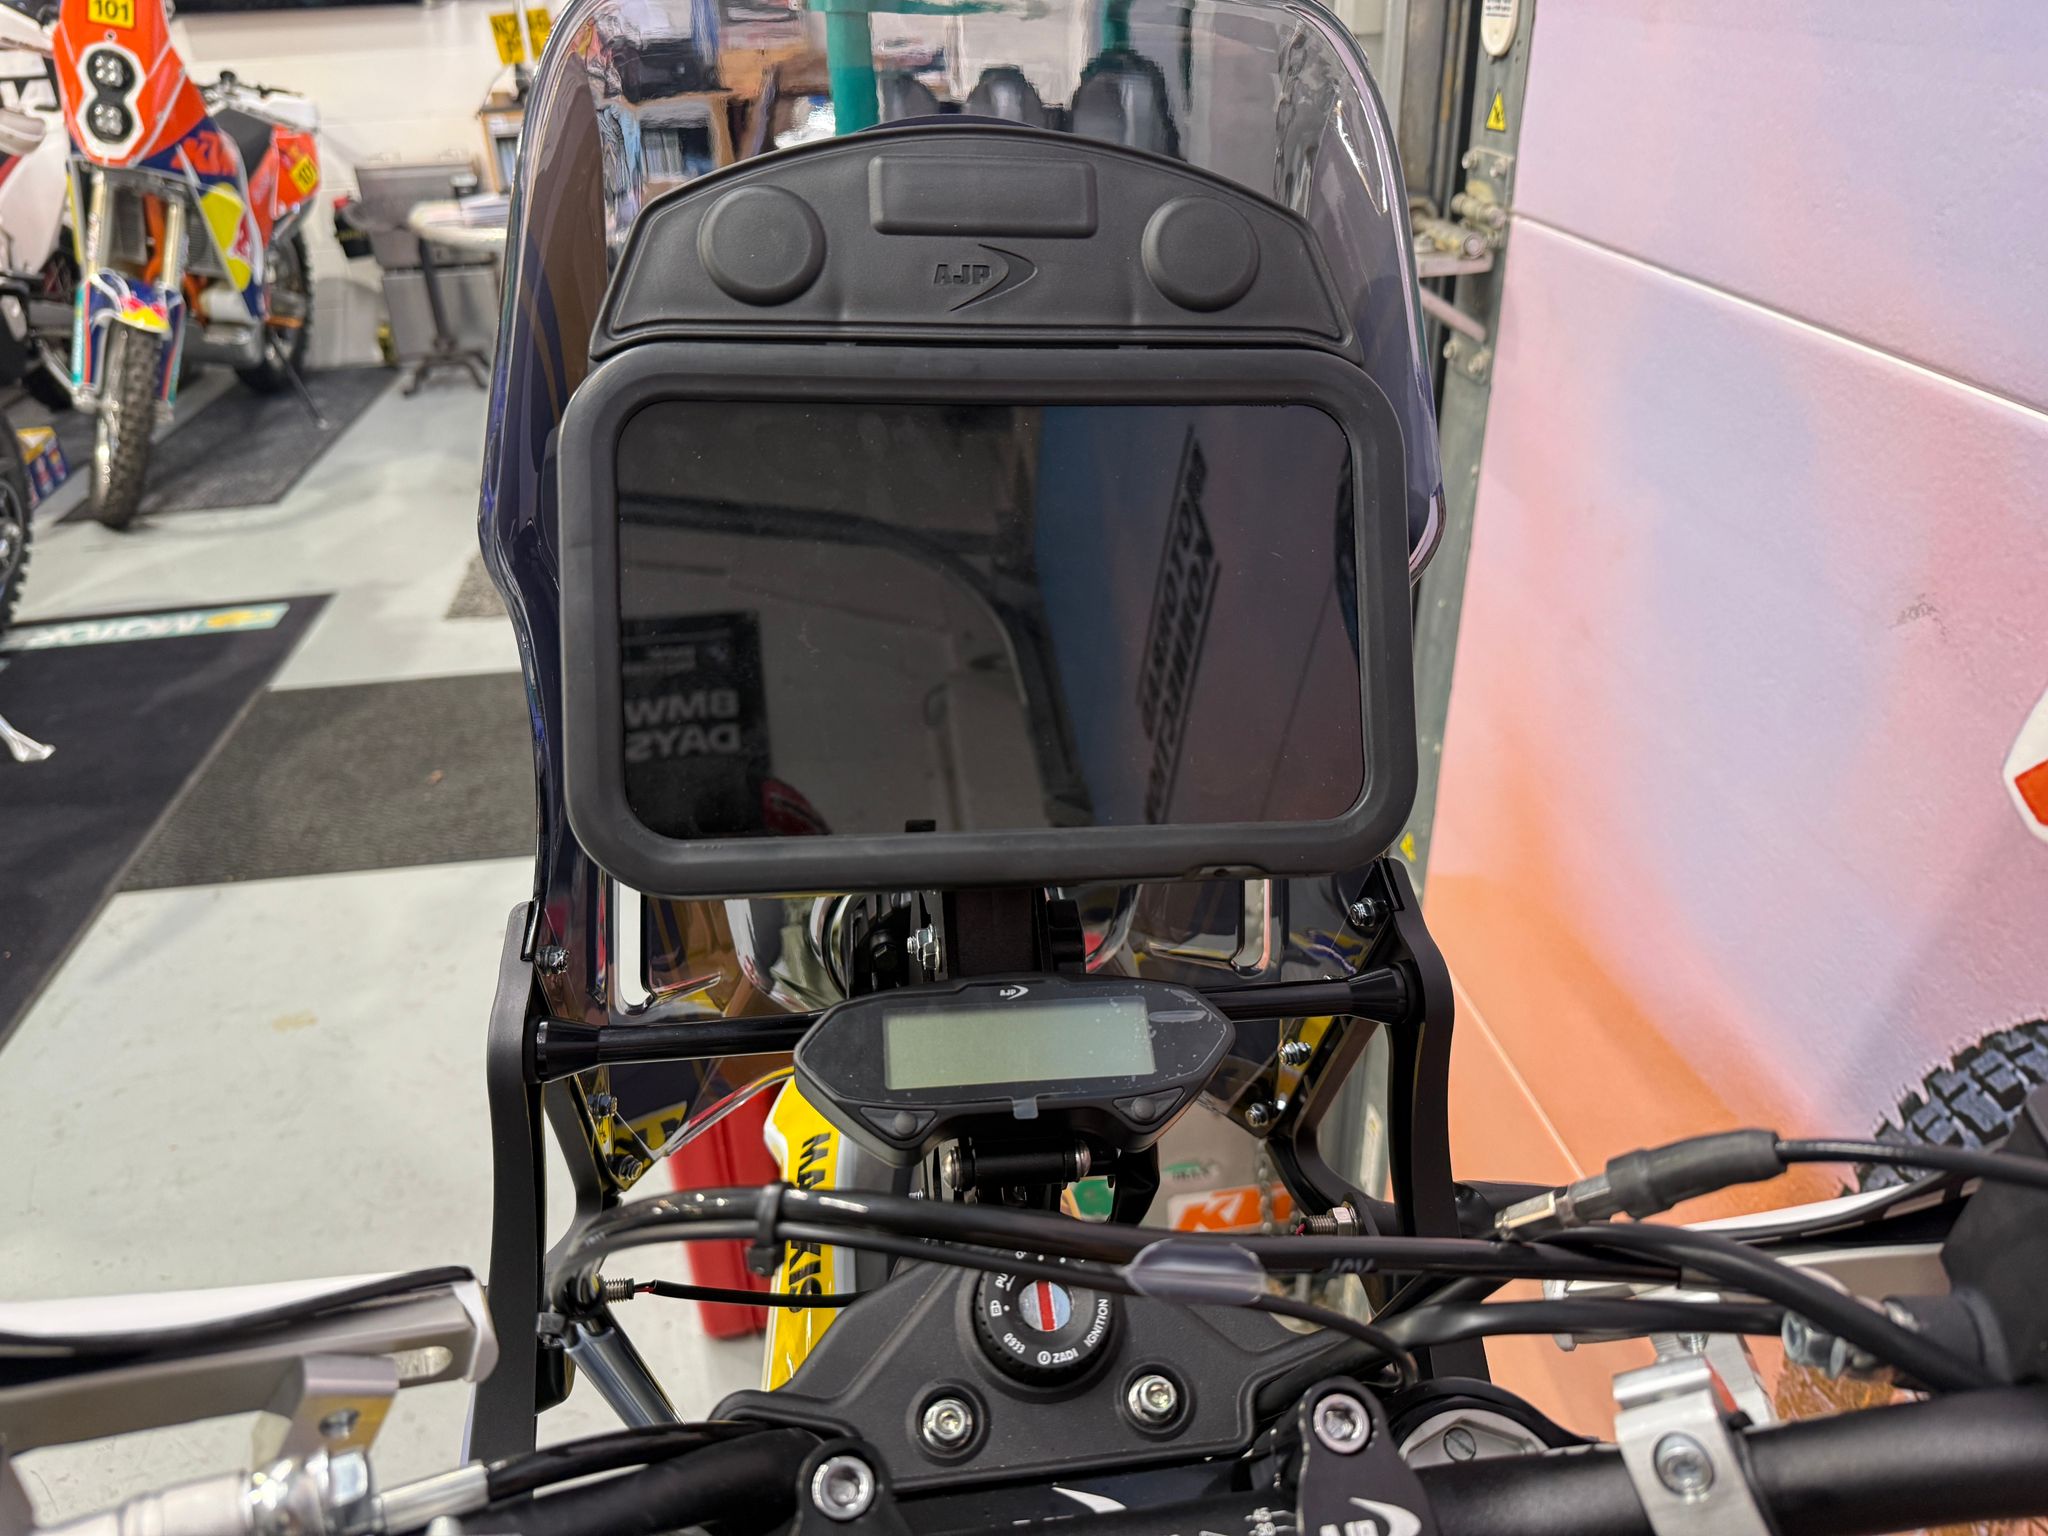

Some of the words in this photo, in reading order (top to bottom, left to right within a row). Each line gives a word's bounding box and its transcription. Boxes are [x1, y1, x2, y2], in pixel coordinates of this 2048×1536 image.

[95, 0, 129, 22] 101
[934, 264, 991, 284] AJP
[788, 1132, 832, 1314] MAXIS
[995, 1272, 1009, 1289] PU
[1083, 1298, 1109, 1348] IGNITION
[1052, 1347, 1079, 1364] ZADI
